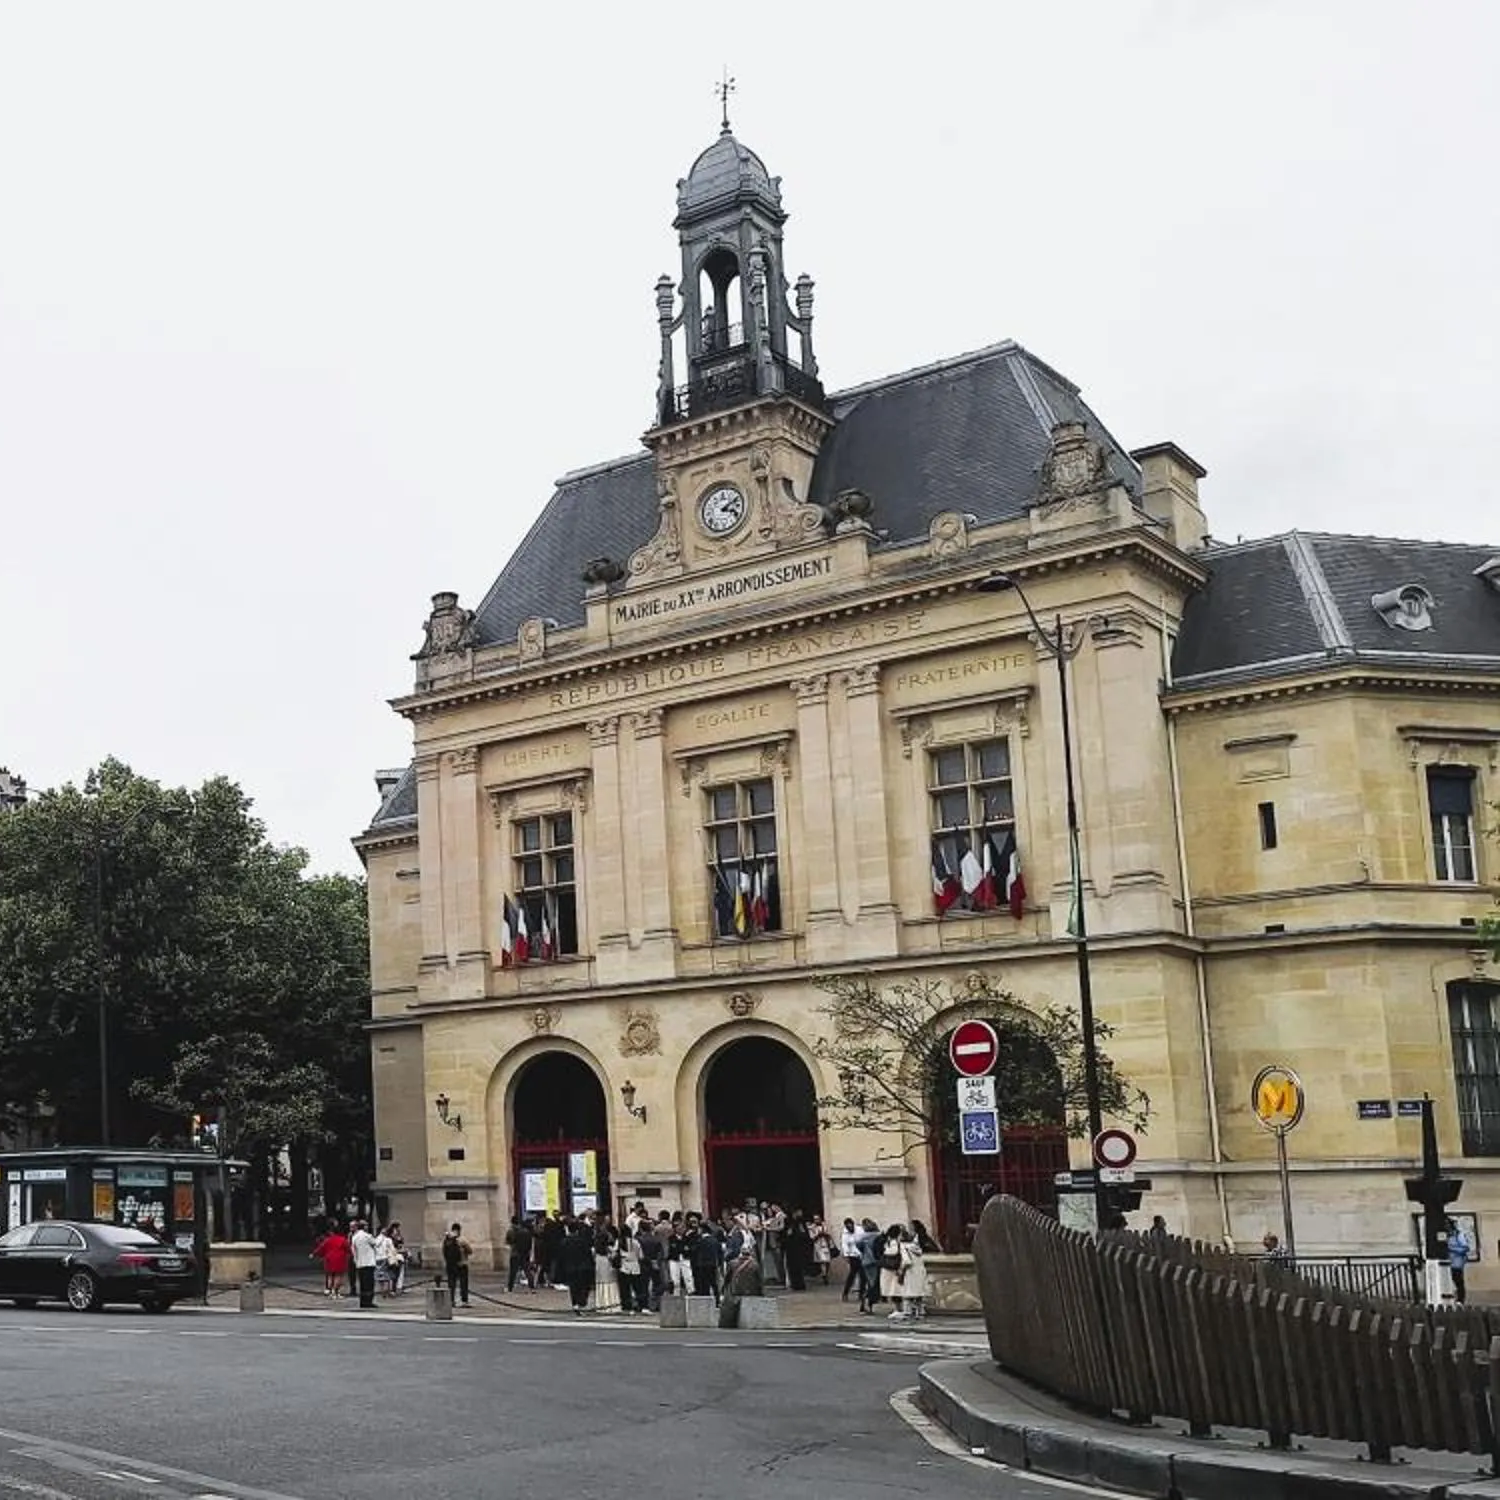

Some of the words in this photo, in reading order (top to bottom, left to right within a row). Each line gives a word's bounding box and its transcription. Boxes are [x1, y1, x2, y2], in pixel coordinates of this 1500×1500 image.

[615, 599, 661, 624] MAIRIE
[708, 556, 832, 601] ARRONDISSEMENT
[1259, 1080, 1297, 1118] M
